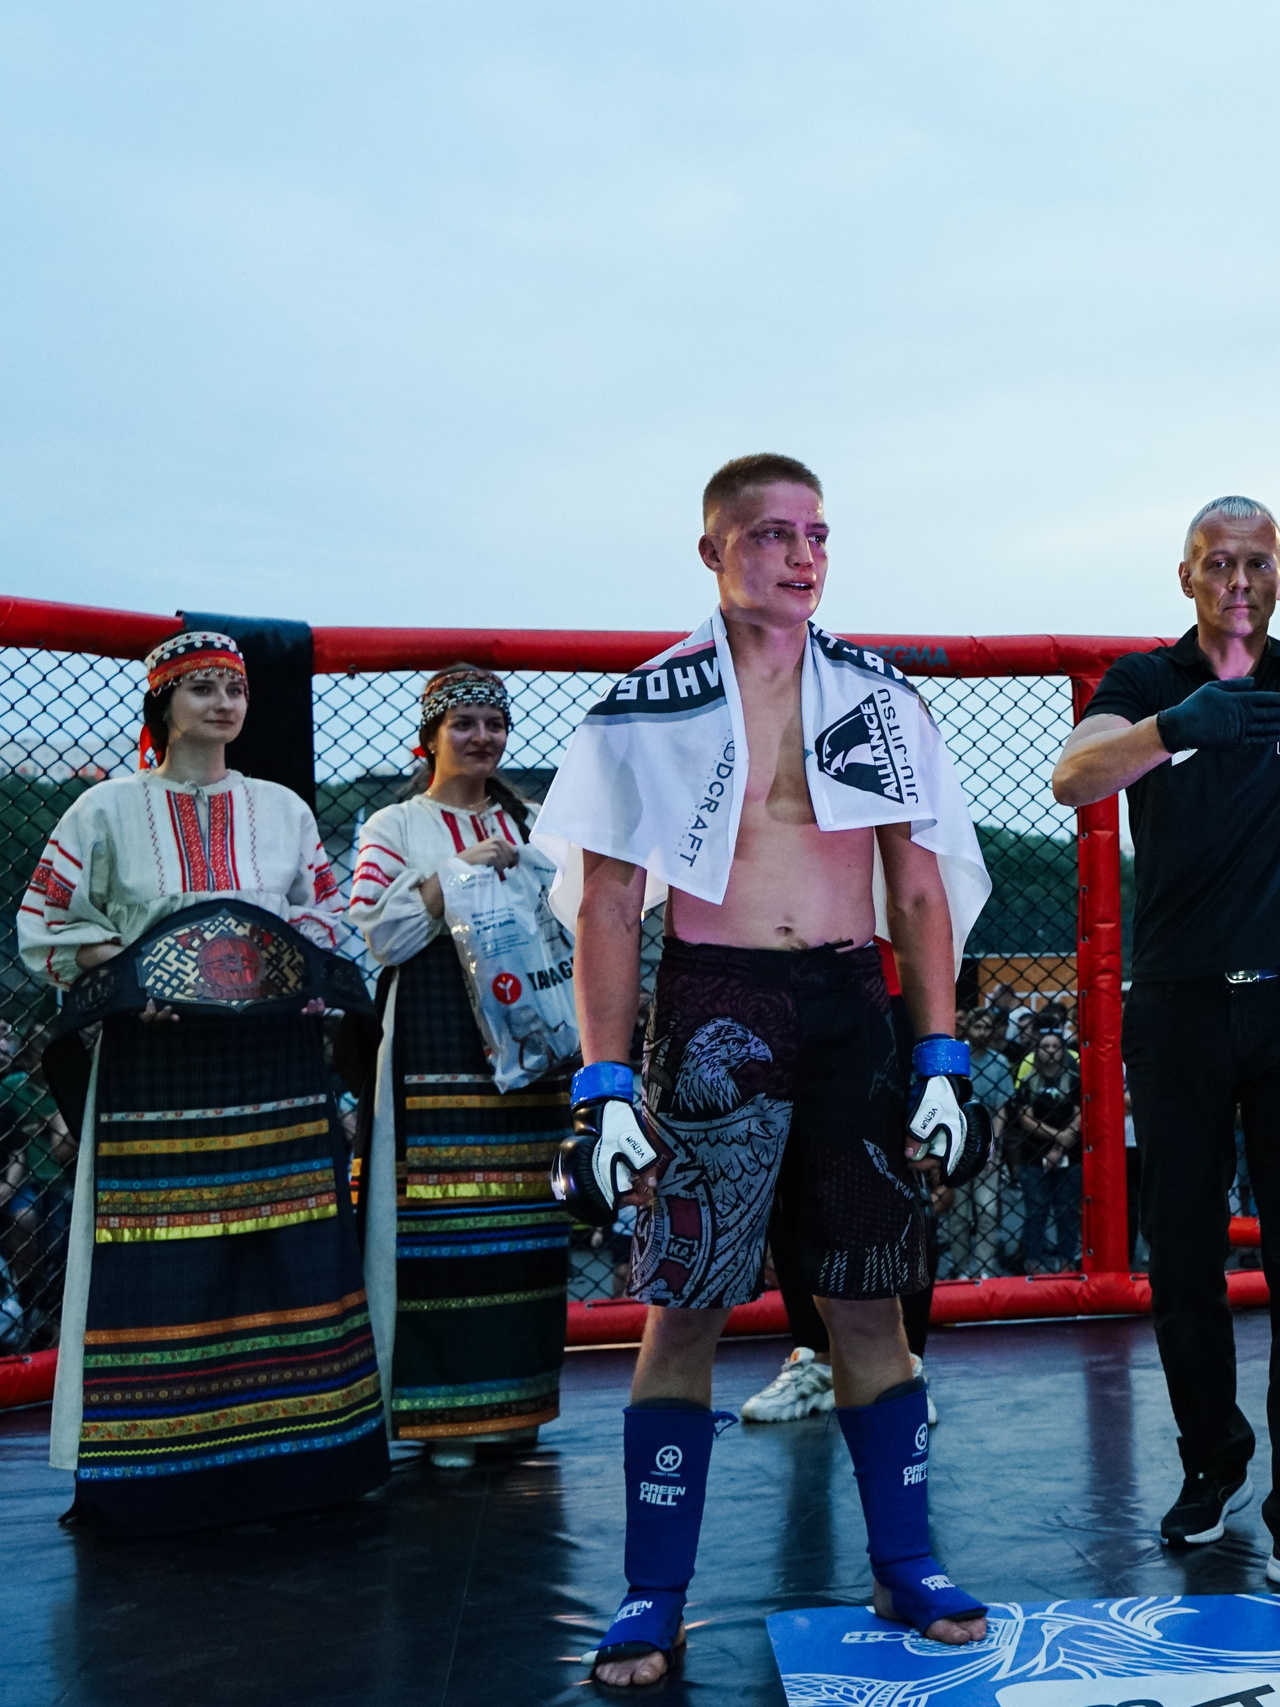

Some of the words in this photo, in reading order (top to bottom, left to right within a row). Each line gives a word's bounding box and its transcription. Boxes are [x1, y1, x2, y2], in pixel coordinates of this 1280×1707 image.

[862, 645, 949, 667] EGMA
[860, 702, 901, 800] ALLIANCE
[877, 689, 918, 803] JIU-JITSU
[920, 1107, 938, 1130] VENUM
[625, 1136, 645, 1159] VENUM
[903, 1460, 928, 1476] GREE
[904, 1472, 928, 1486] HILL
[639, 1490, 677, 1506] HILL
[640, 1482, 686, 1496] GREEN
